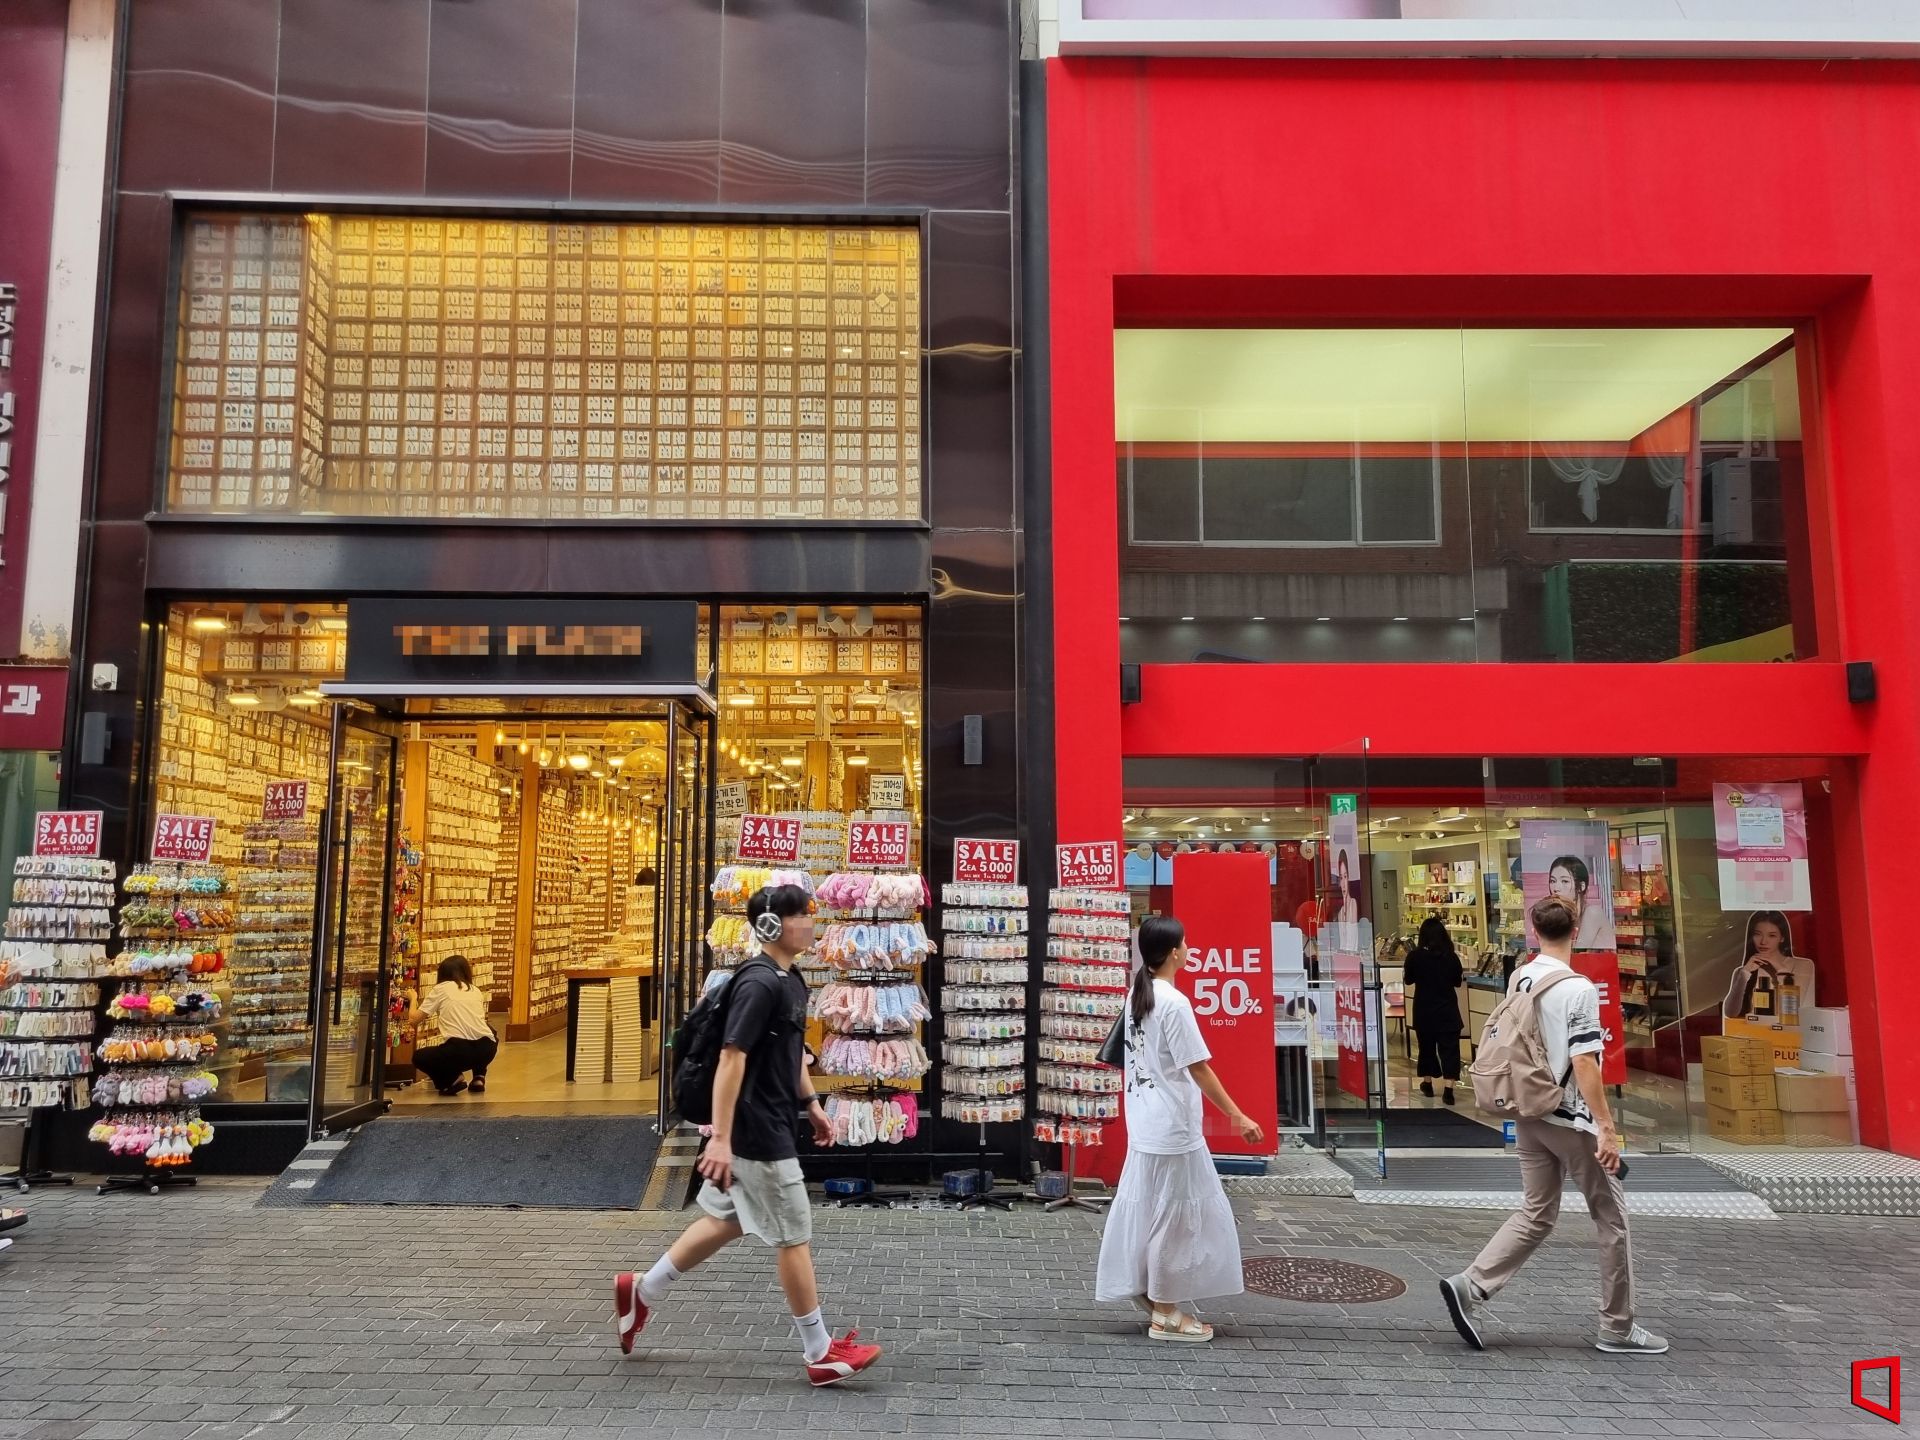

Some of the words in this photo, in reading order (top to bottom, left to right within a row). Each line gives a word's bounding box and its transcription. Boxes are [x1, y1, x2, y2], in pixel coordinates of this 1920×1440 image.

[0, 685, 42, 715] 과
[883, 780, 902, 790] 피어싱
[266, 785, 305, 800] SALE
[716, 787, 738, 799] 게핀
[872, 791, 901, 802] 가격확인
[265, 802, 278, 811] 2EA
[715, 797, 745, 810] 격확인
[40, 817, 96, 833] SALE
[158, 820, 210, 839] SALE
[744, 820, 796, 839] SALE
[39, 835, 57, 846] 2EA
[852, 827, 905, 842] SALE
[157, 836, 173, 848] 2EA
[742, 836, 760, 848] 2EA
[852, 843, 869, 854] 2EA
[958, 844, 1013, 861] SALE
[1060, 848, 1113, 865] SALE
[959, 860, 977, 871] 2EA
[1063, 866, 1078, 877] 2EA
[1184, 948, 1261, 973] SALE
[1194, 979, 1262, 1016] 50%
[1339, 985, 1361, 1012] SALE
[1209, 1018, 1223, 1026] (up
[1225, 1018, 1237, 1026] to)
[1342, 1014, 1363, 1053] 50%
